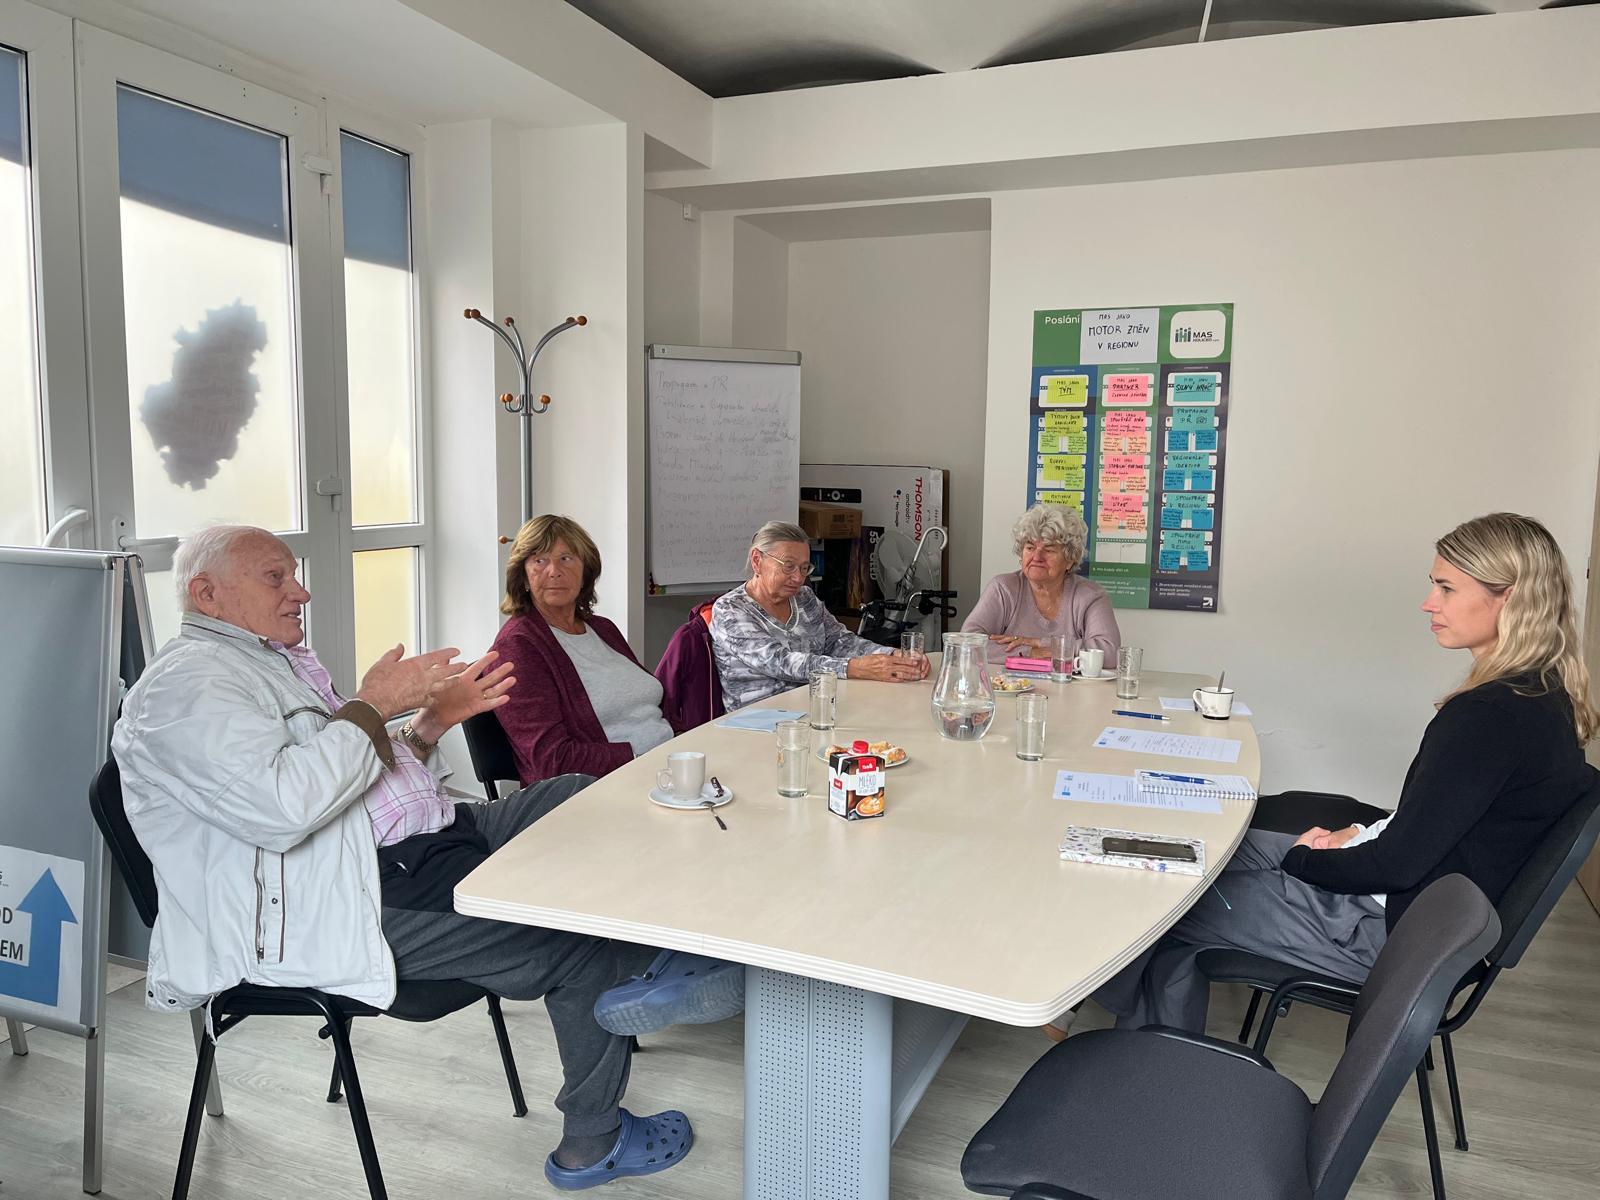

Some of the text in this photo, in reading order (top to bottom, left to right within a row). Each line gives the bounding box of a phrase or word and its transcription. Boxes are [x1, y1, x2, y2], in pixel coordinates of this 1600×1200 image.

[1045, 313, 1080, 325] Poslání
[1088, 323, 1150, 337] MOTOR ZMĚN
[1097, 341, 1139, 350] V REGIONU
[915, 477, 923, 541] THOMSON
[869, 530, 879, 544] 55
[0, 907, 13, 925] D
